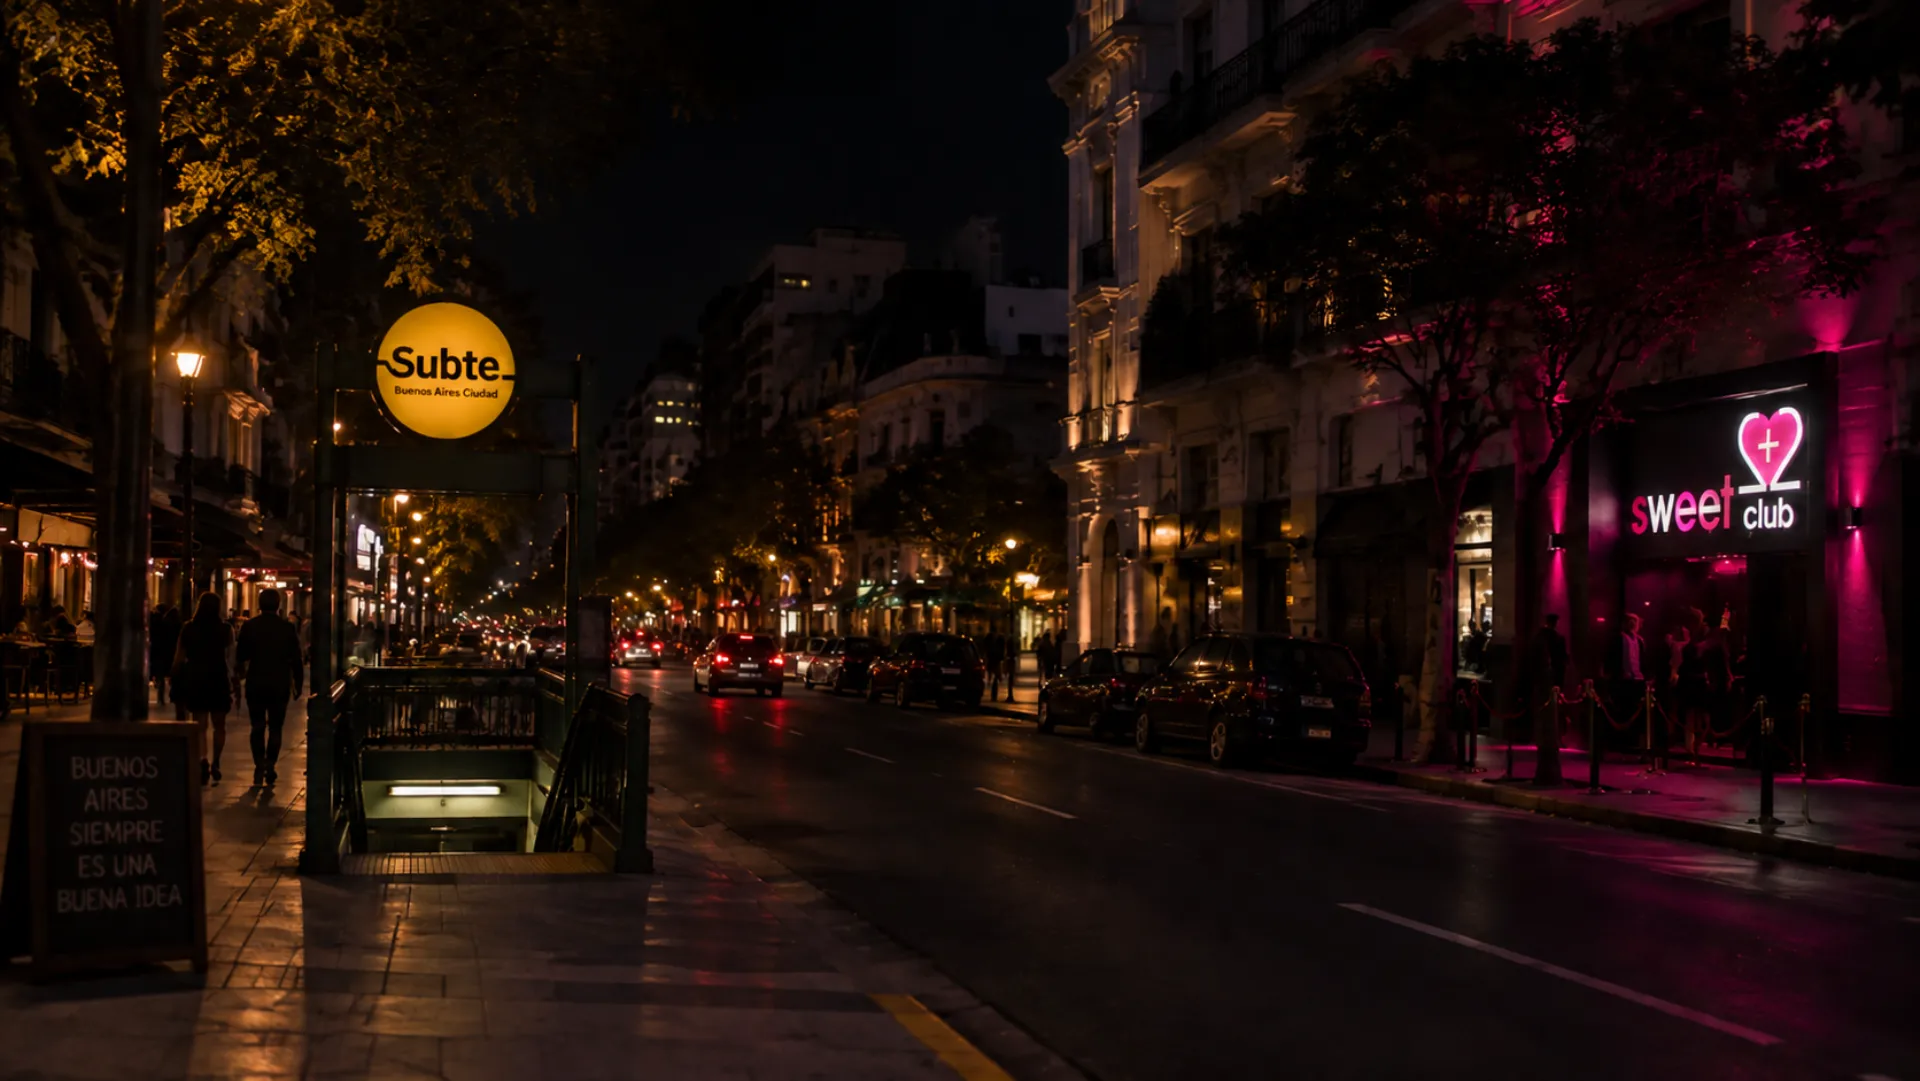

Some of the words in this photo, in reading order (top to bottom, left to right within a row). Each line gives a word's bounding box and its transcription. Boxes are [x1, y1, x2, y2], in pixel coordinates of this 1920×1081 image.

[386, 346, 499, 381] Subte
[394, 386, 432, 396] Buenos
[434, 387, 461, 397] Aires
[463, 388, 498, 398] Ciudad
[1631, 473, 1735, 535] sweet
[1743, 497, 1795, 530] club
[71, 756, 159, 780] BUENOS
[84, 787, 149, 812] AIRES
[69, 820, 165, 847] SIEMPRE
[78, 854, 106, 879] ES
[113, 853, 157, 878] UNA
[57, 886, 128, 914] BUENA
[134, 884, 183, 908] IDEA
